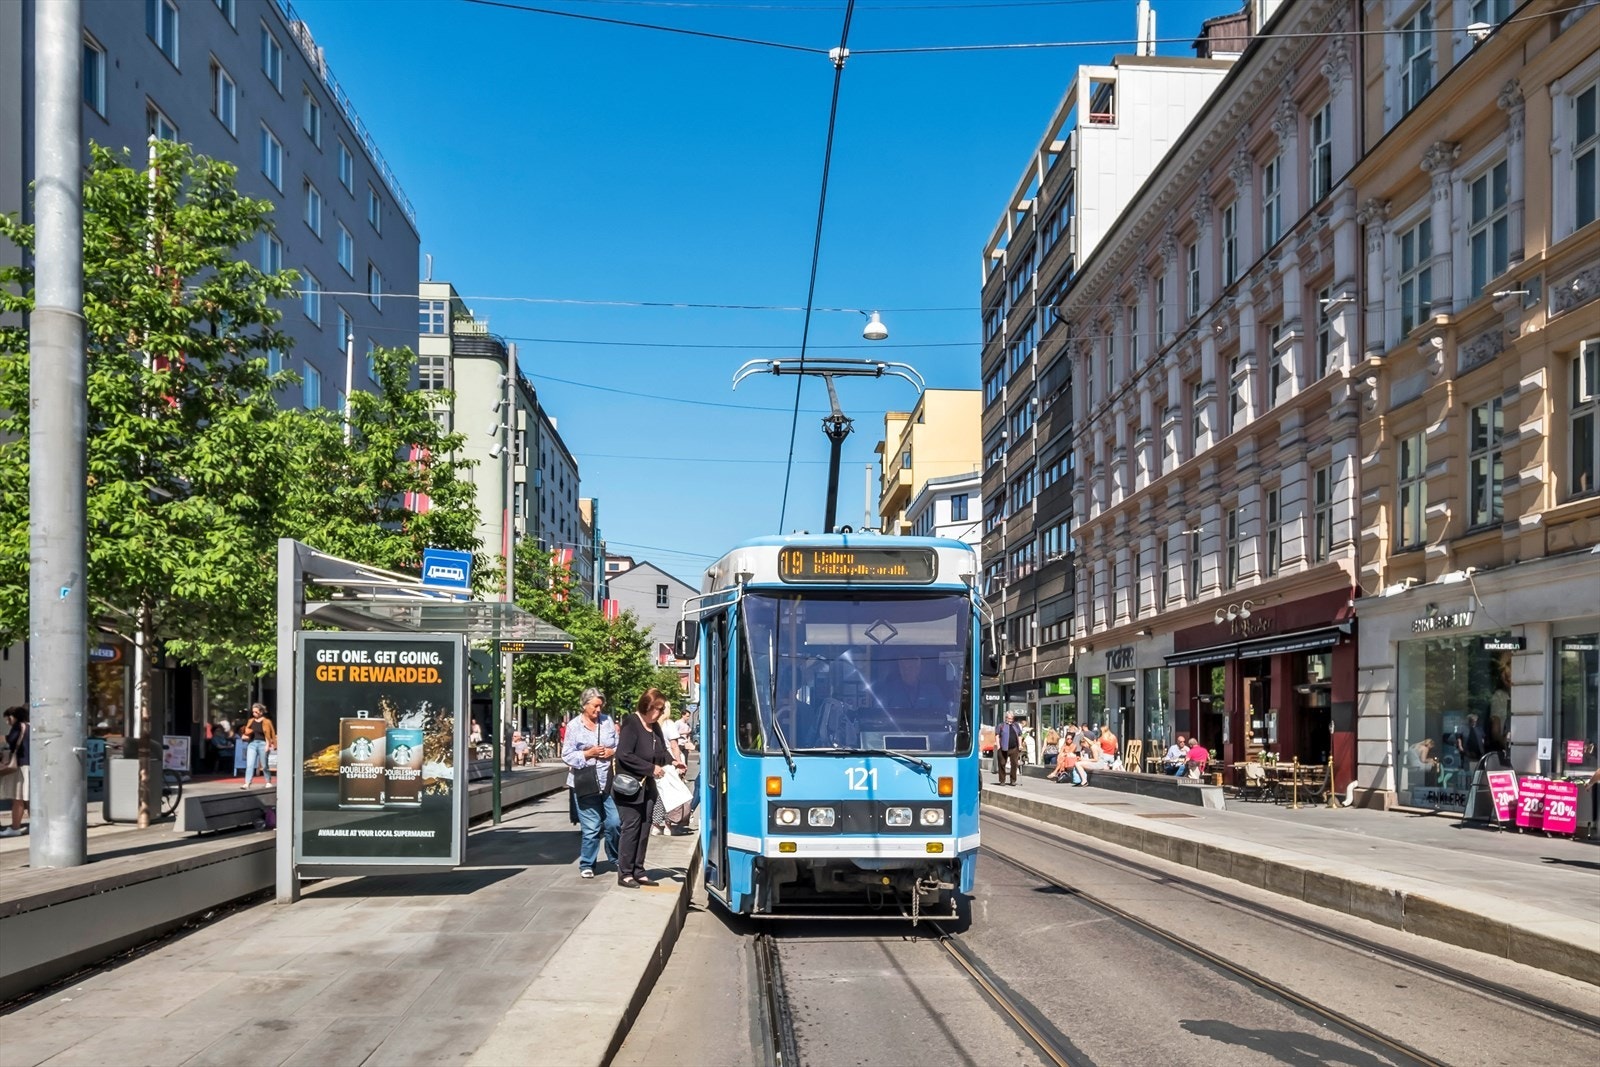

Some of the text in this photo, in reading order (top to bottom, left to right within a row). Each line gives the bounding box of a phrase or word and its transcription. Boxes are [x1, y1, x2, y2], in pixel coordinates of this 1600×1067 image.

[316, 649, 443, 664] GET ONE. GET GOING.
[316, 665, 442, 683] GET REWARDED.
[340, 766, 383, 774] DOUBLESHOT
[844, 767, 878, 791] 121
[1545, 800, 1576, 817] -20%
[318, 829, 436, 838] AVAILABLE AT YOUR LOCAL SUPERMARKET
